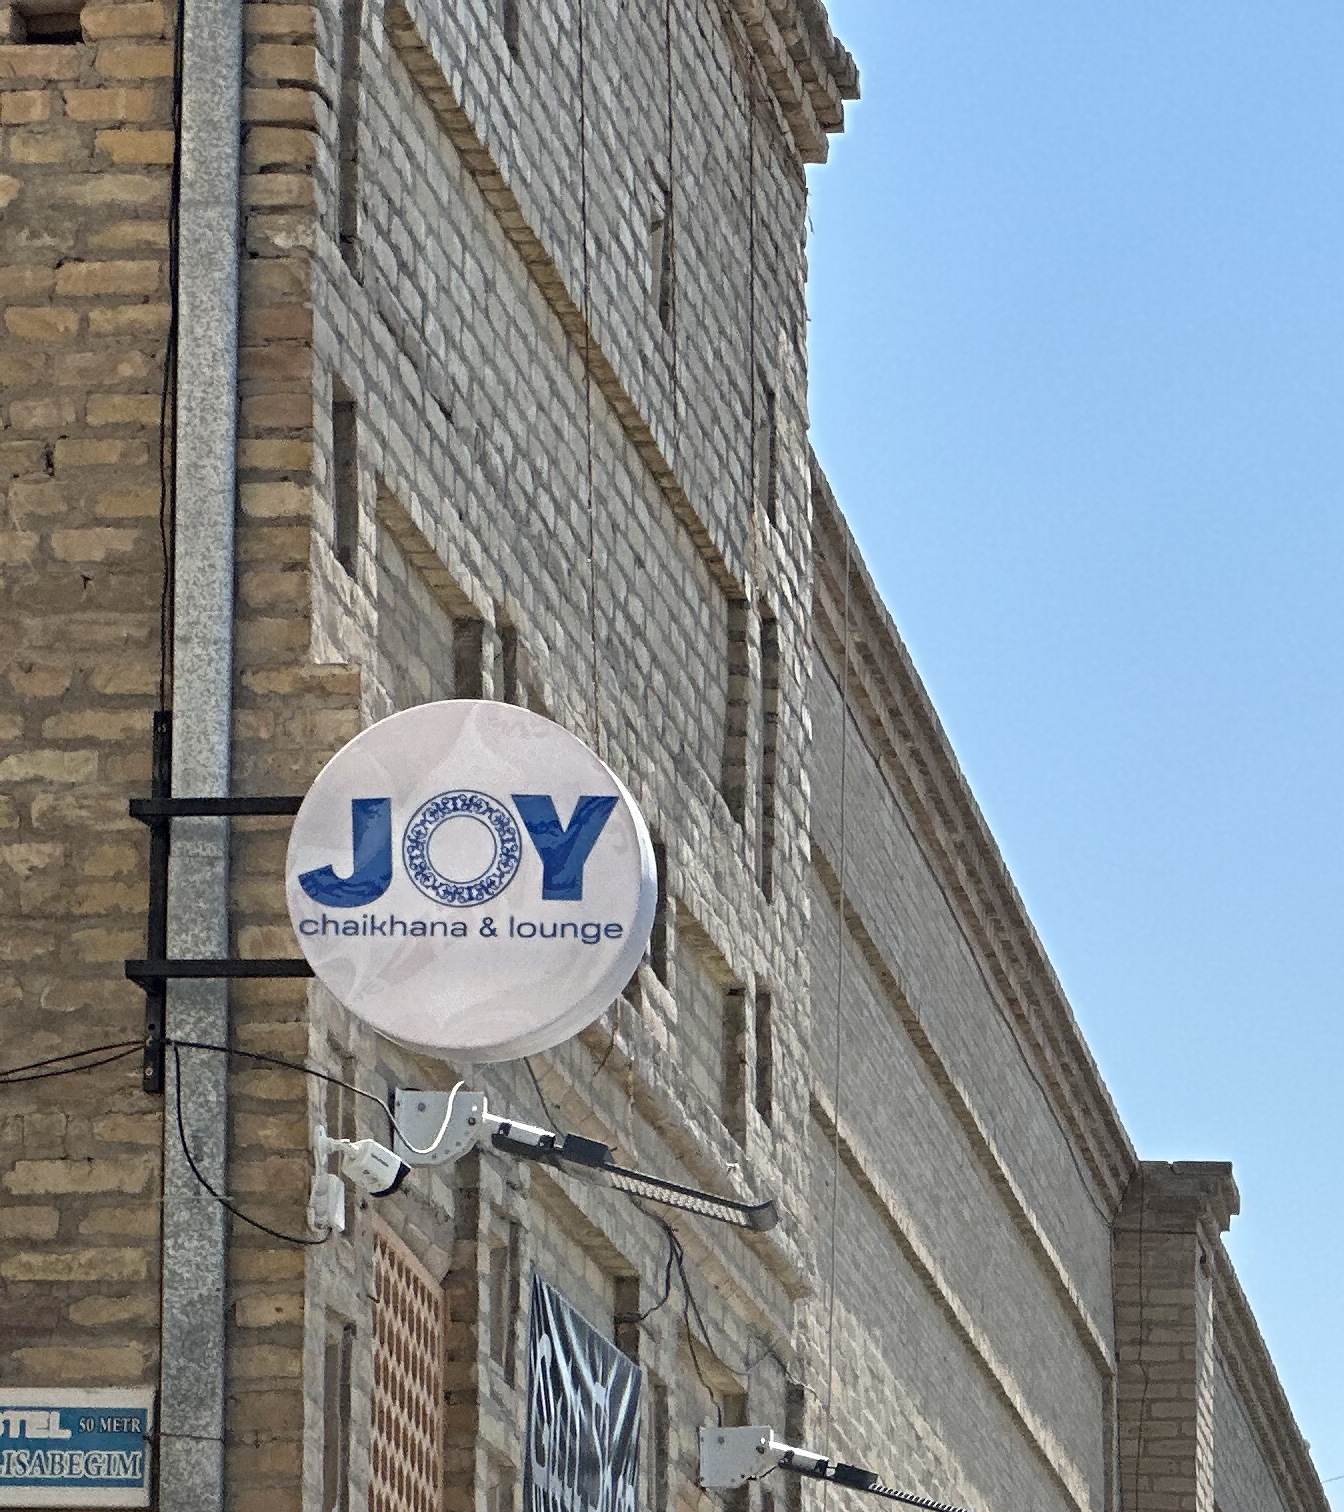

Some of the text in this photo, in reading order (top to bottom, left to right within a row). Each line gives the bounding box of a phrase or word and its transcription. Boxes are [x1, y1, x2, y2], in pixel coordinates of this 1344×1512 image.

[298, 789, 619, 908] JOY
[299, 913, 624, 945] chaikhana & lounge
[99, 1417, 142, 1433] METR
[0, 1450, 142, 1478] ISABEGIM
